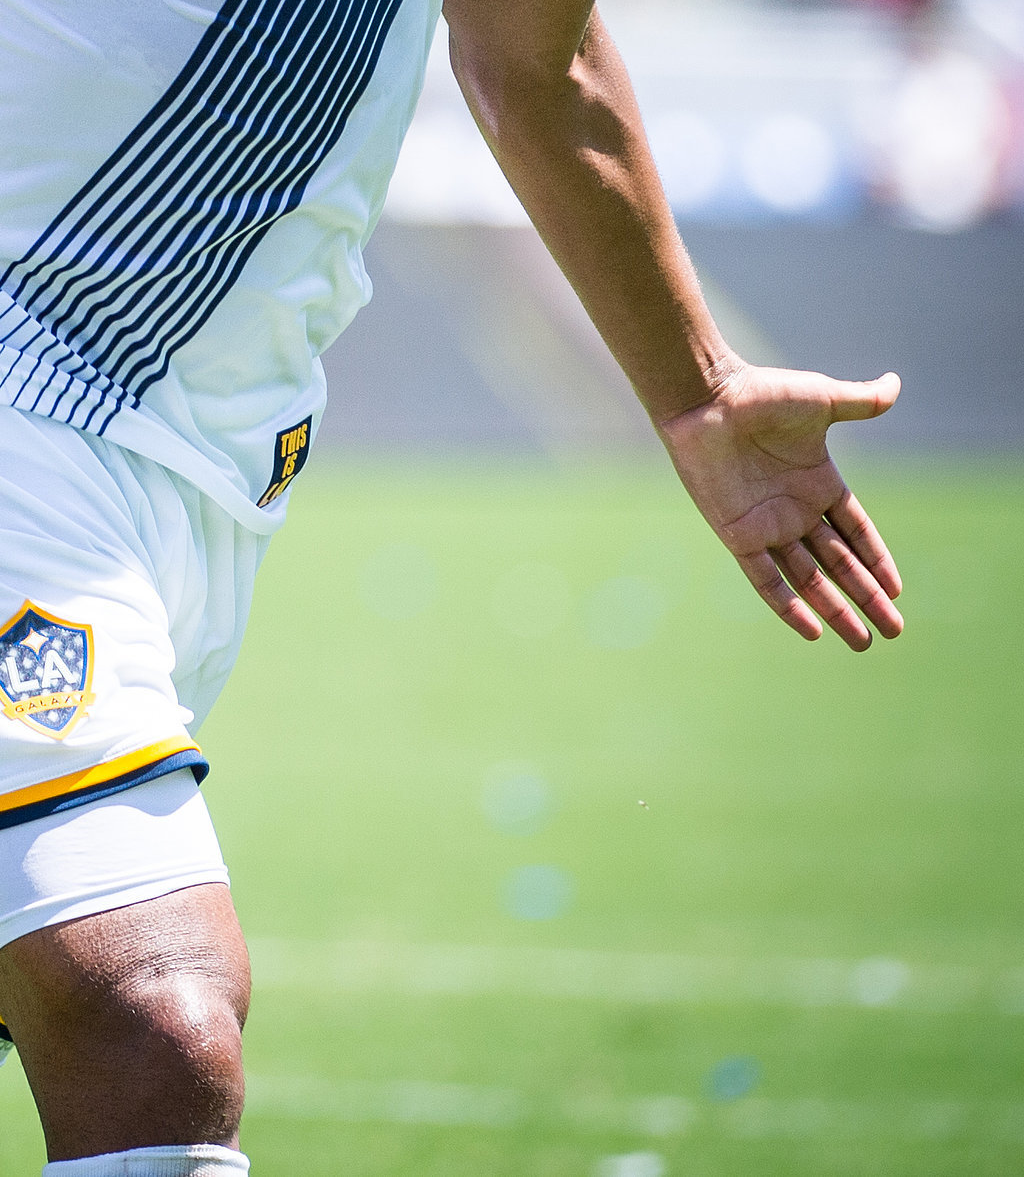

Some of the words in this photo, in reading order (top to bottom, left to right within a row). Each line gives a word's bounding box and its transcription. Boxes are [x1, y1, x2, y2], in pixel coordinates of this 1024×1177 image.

[281, 423, 308, 457] THIS
[282, 452, 297, 478] IS
[5, 649, 77, 693] LA
